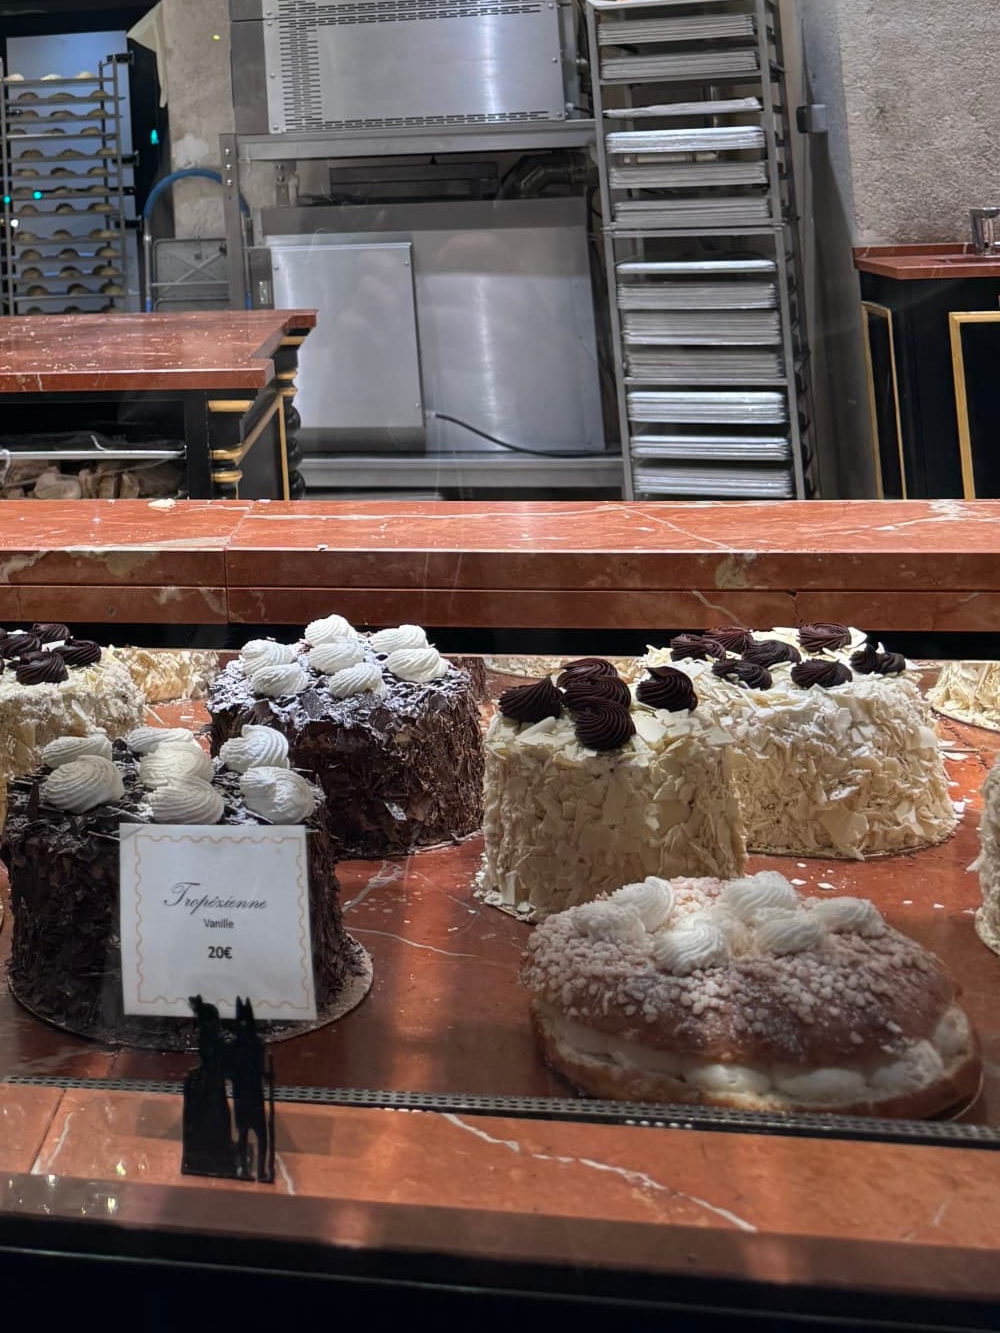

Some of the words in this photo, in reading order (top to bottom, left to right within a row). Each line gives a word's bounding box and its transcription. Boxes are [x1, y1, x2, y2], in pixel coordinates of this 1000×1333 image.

[163, 881, 268, 915] Tropézienne
[203, 918, 235, 929] Vanille
[207, 945, 233, 960] 20€
